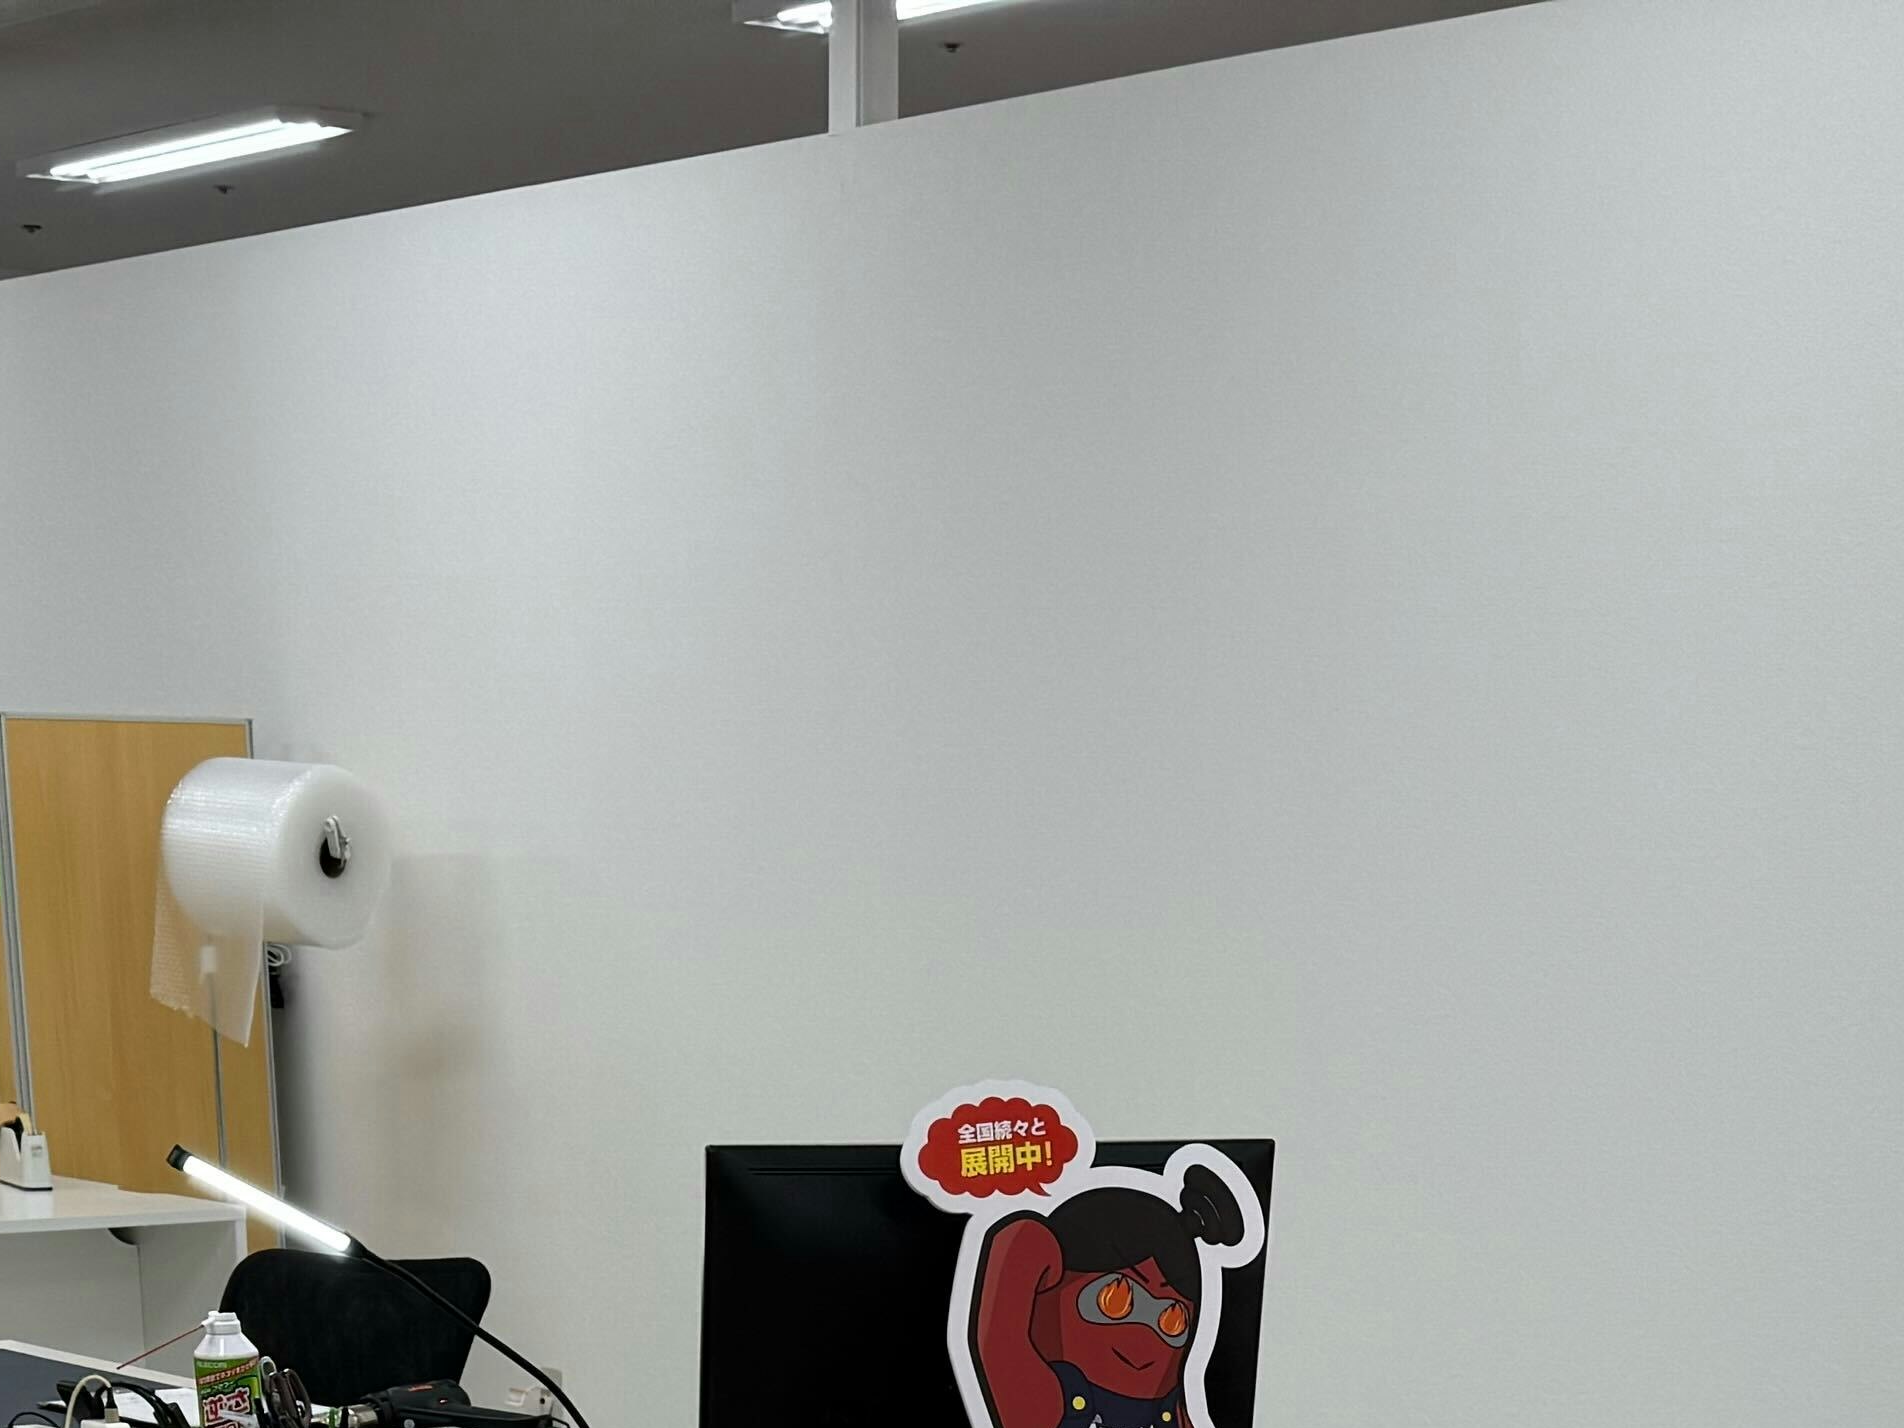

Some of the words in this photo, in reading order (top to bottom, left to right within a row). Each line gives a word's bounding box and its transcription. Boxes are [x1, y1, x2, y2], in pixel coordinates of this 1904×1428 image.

[958, 1117, 1046, 1144] 全国続々と
[961, 1141, 1053, 1177] 展開中!
